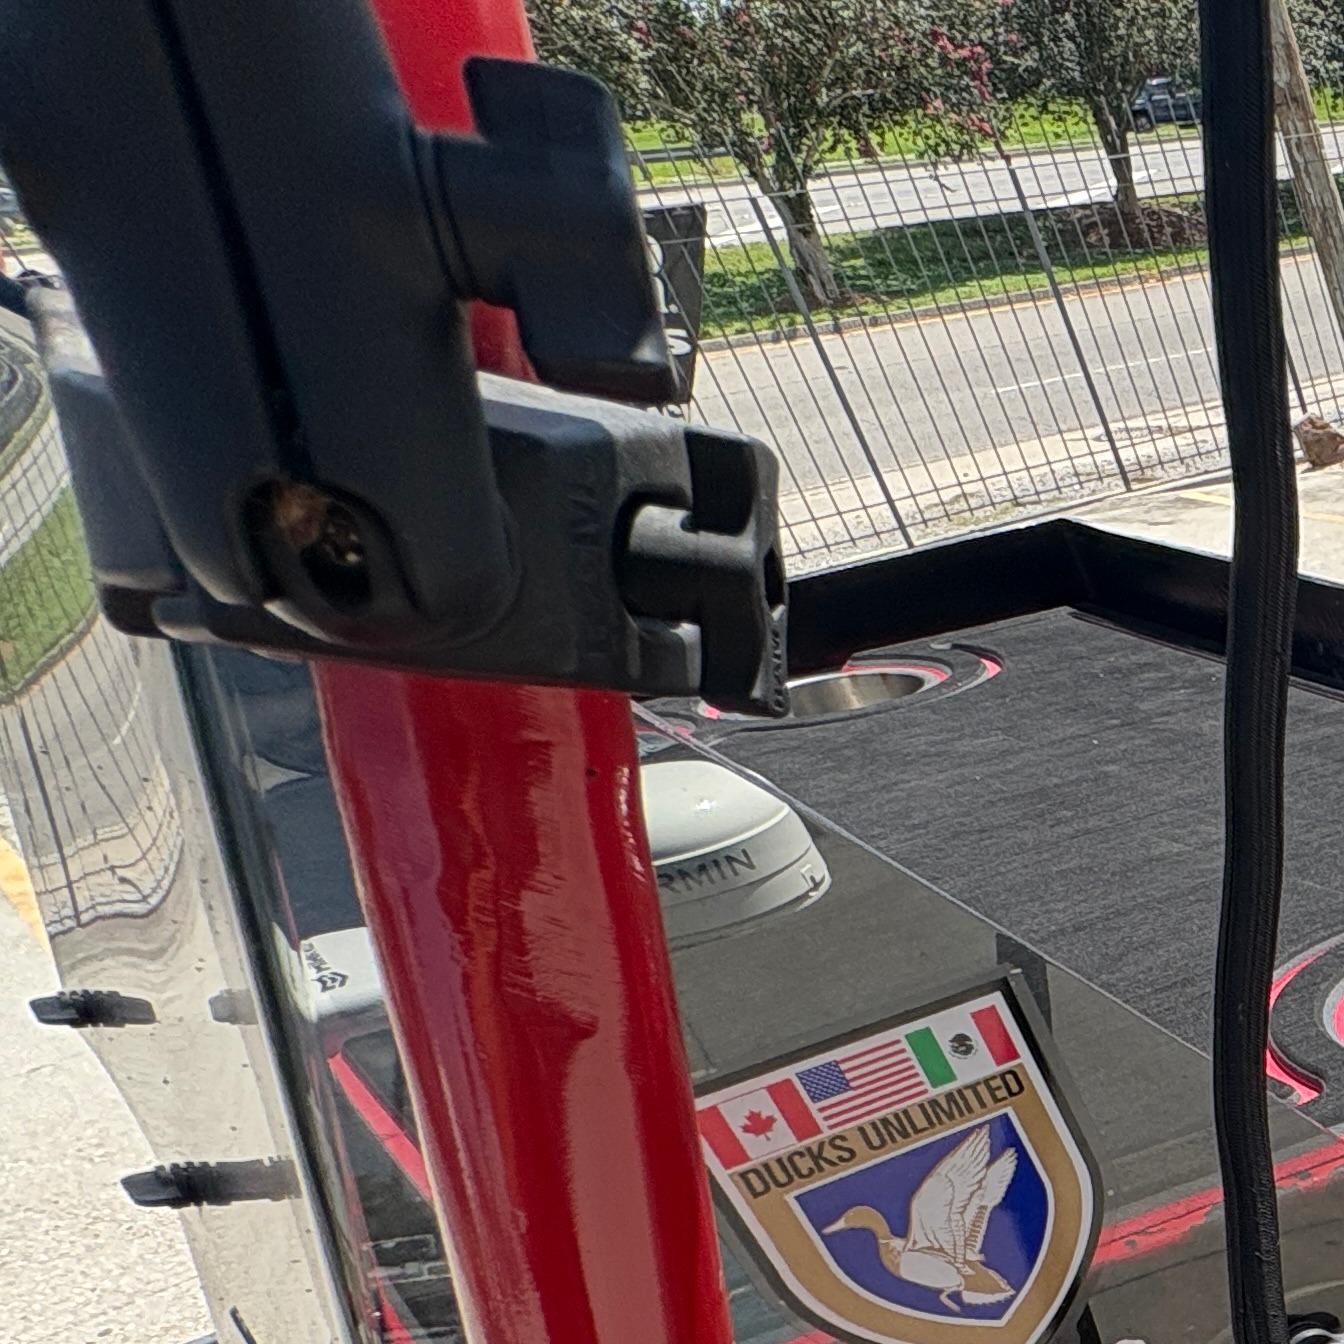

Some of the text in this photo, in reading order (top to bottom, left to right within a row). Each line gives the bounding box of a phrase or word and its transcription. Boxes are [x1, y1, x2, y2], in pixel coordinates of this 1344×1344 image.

[656, 847, 757, 894] RMIN
[738, 1069, 1026, 1200] DUCKS UNLIMITED
